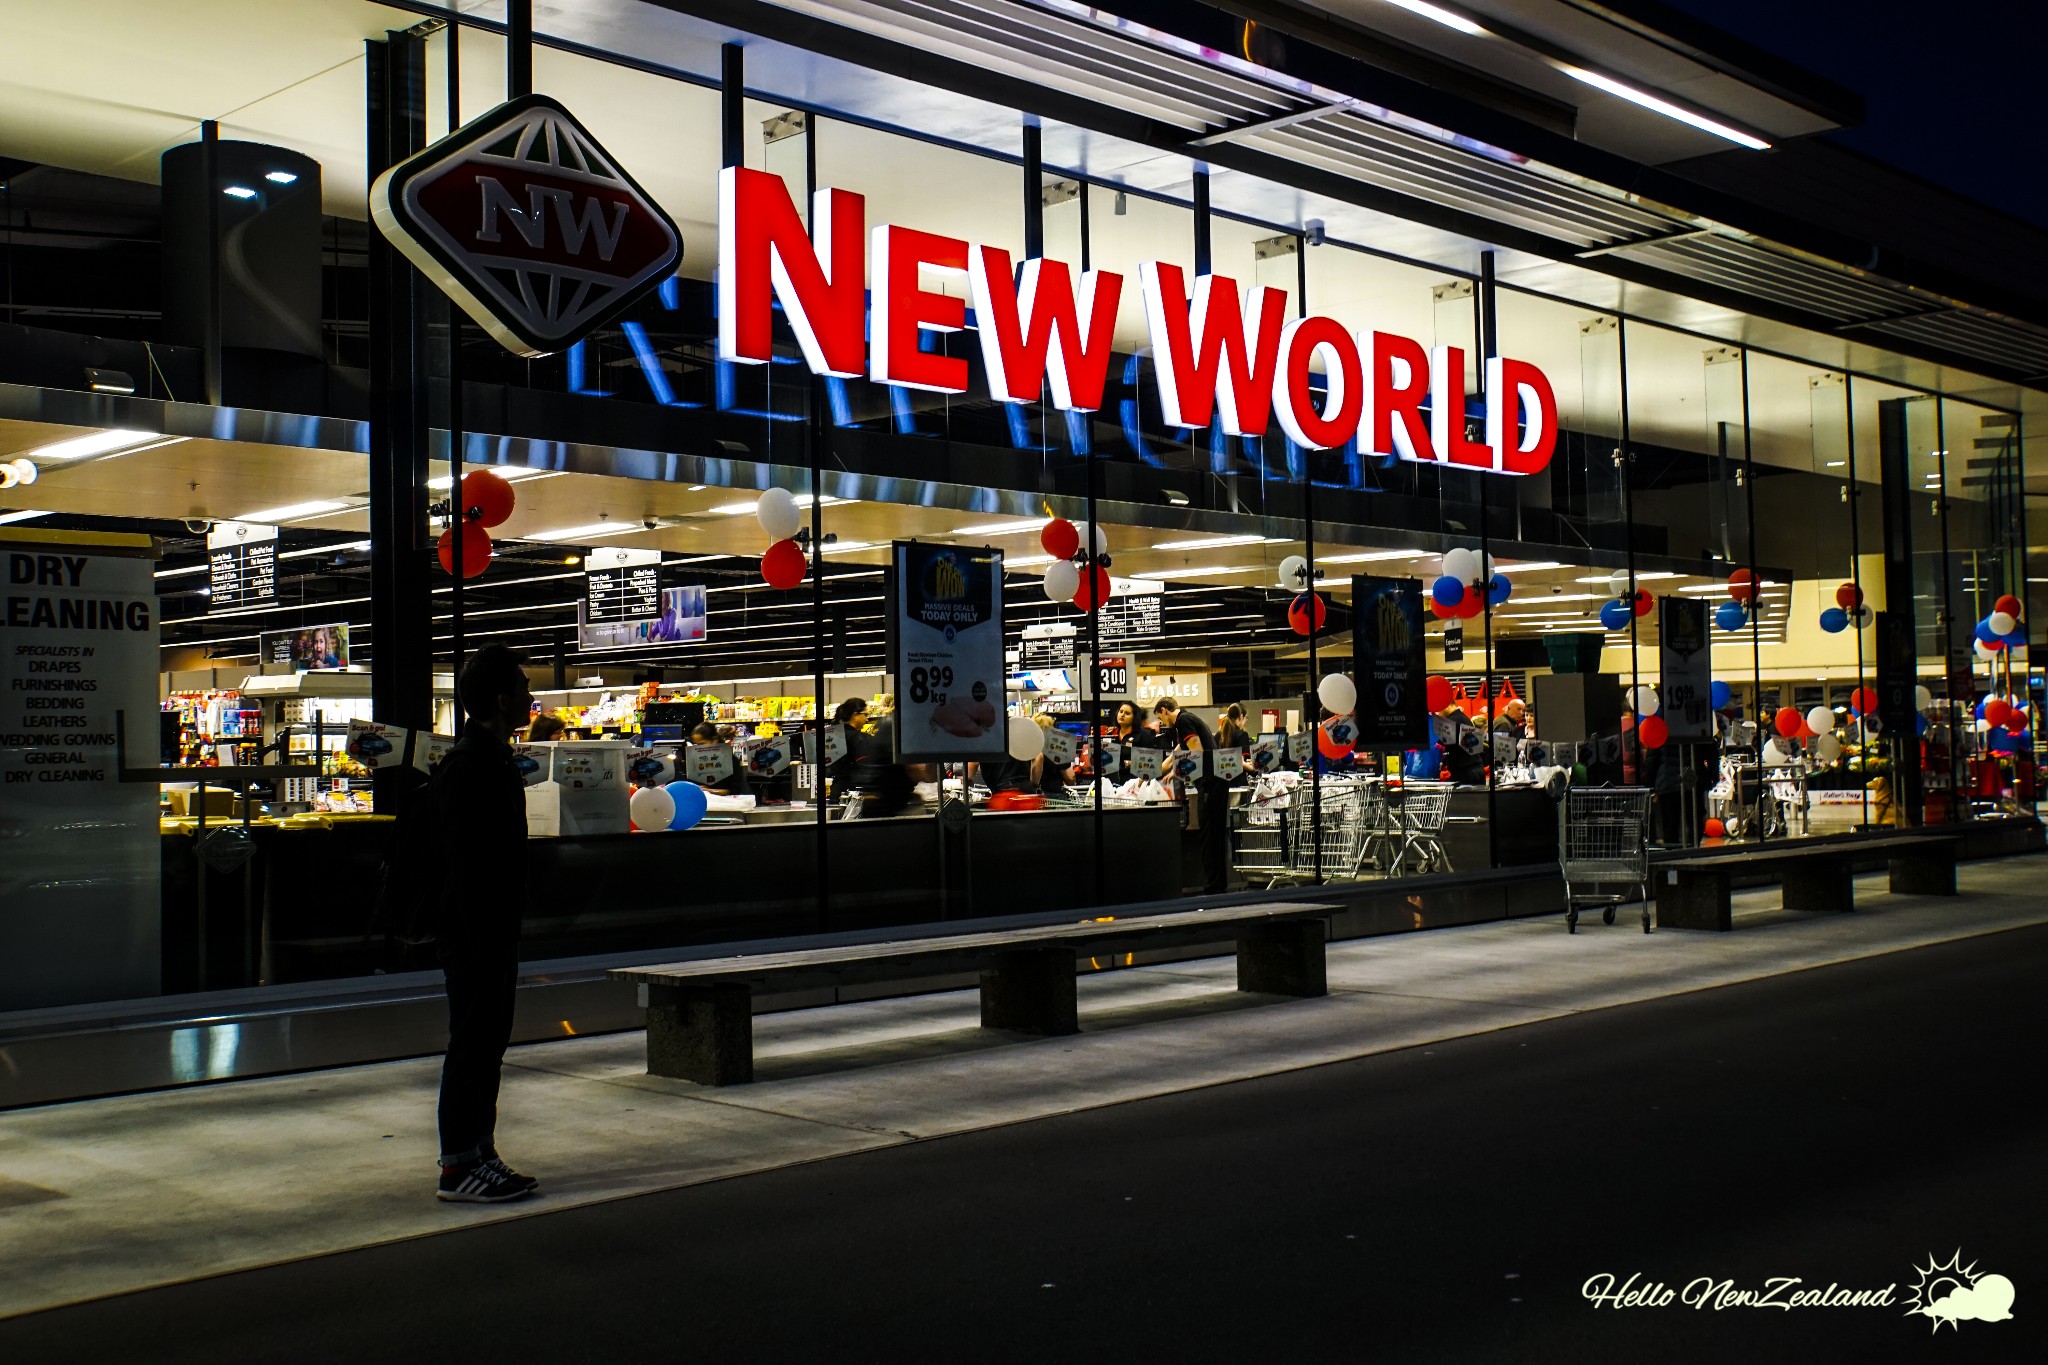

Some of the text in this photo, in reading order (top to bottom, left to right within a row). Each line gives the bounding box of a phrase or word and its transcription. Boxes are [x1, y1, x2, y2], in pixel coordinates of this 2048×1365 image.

[475, 174, 630, 262] NW
[718, 165, 1557, 476] NEW WORLD
[10, 553, 88, 587] DRY
[924, 602, 975, 612] MASSIVE DEALS
[0, 596, 149, 632] EANING
[920, 610, 978, 622] TODAY ONLY
[15, 645, 95, 657] SPECIALISTS IN
[29, 661, 81, 673] DRAPES
[12, 679, 97, 692] FURNISHINGS
[26, 697, 84, 709] BEDDING
[930, 690, 947, 707] kg
[23, 715, 87, 728] LEATHERS
[351, 724, 369, 732] Scan
[375, 725, 386, 733] go!
[64, 734, 116, 746] GOWNS
[748, 743, 761, 752] Scan
[25, 752, 86, 764] GENERAL
[627, 752, 640, 760] Scan
[5, 770, 104, 783] DRY CLEANING
